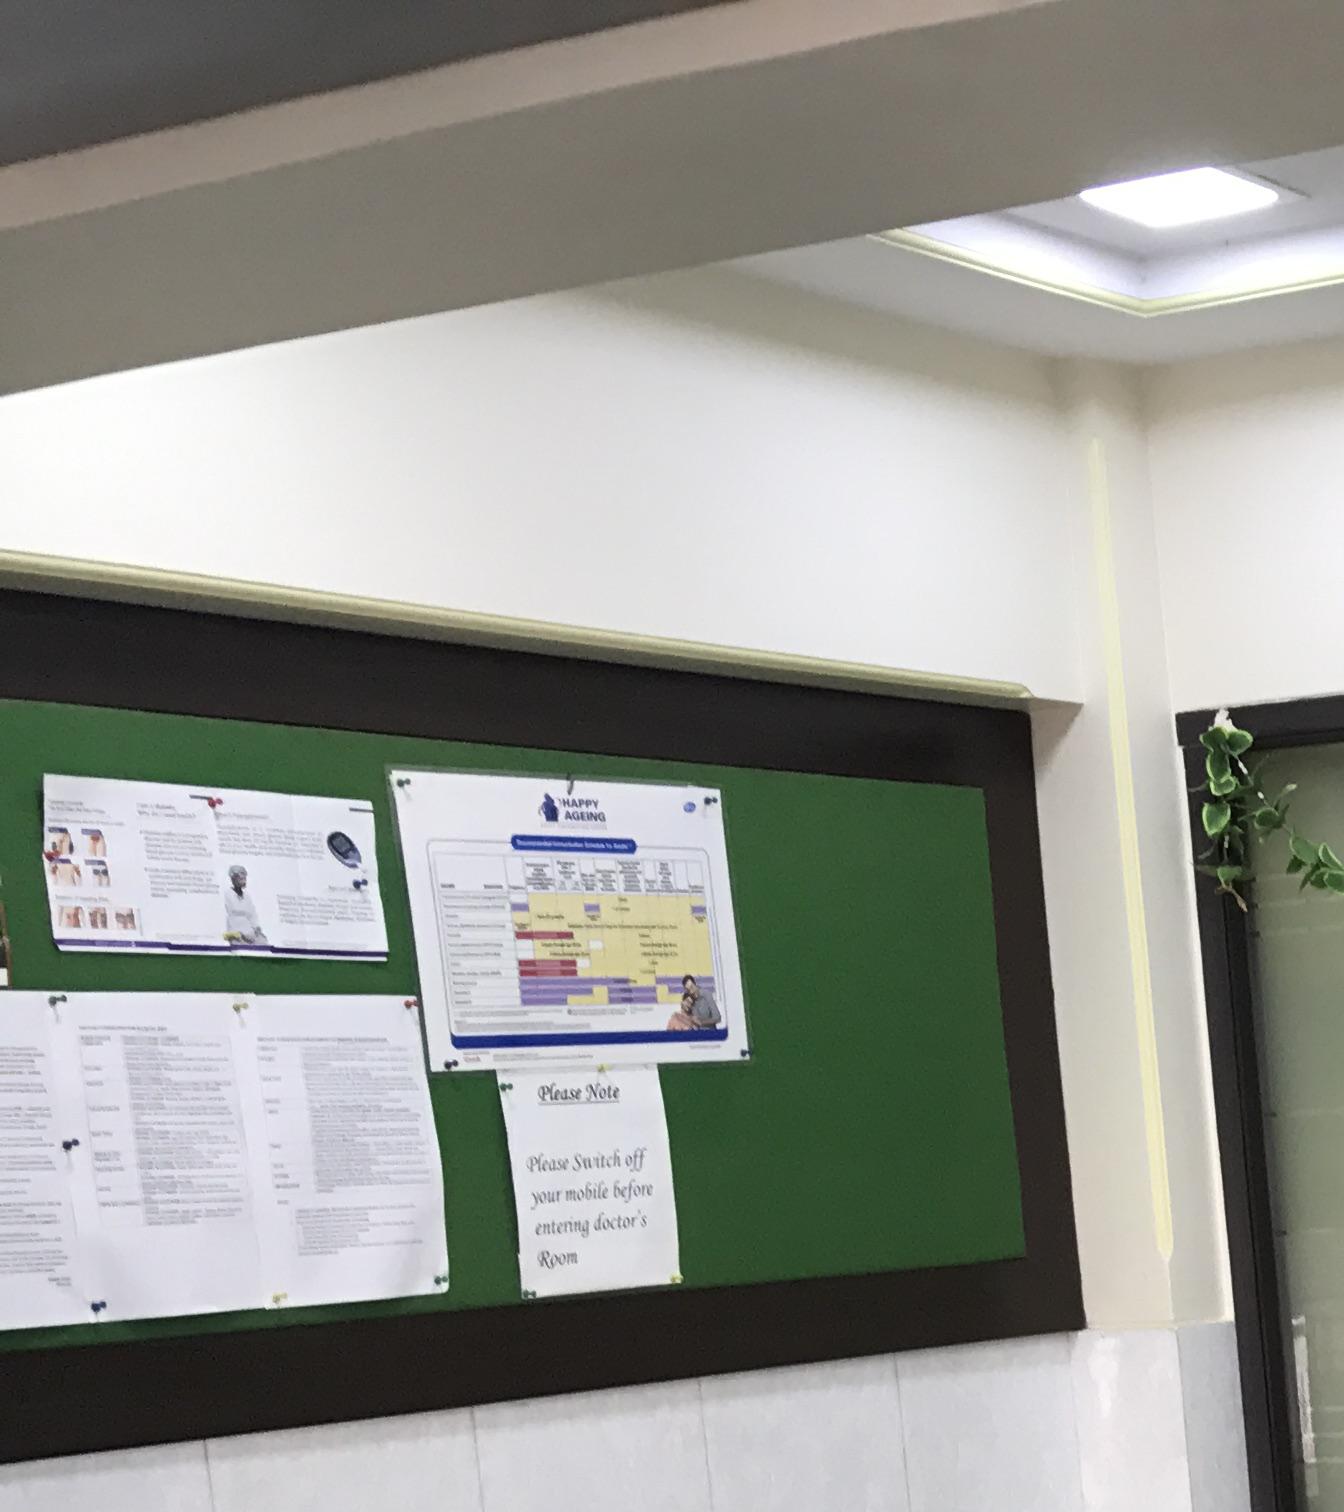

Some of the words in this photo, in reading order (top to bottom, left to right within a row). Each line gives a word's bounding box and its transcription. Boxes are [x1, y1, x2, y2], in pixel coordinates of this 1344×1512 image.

[562, 798, 599, 810] HAPPY
[564, 811, 606, 823] AGEING
[538, 1083, 582, 1102] Please
[586, 1083, 620, 1101] Note
[526, 1152, 570, 1173] Please
[572, 1149, 622, 1172] Switch
[625, 1147, 648, 1172] off
[530, 1189, 561, 1210] your
[565, 1181, 609, 1202] mobile
[613, 1179, 654, 1202] before
[535, 1216, 590, 1238] entering
[593, 1209, 648, 1230] doctor's
[537, 1250, 579, 1269] Room
